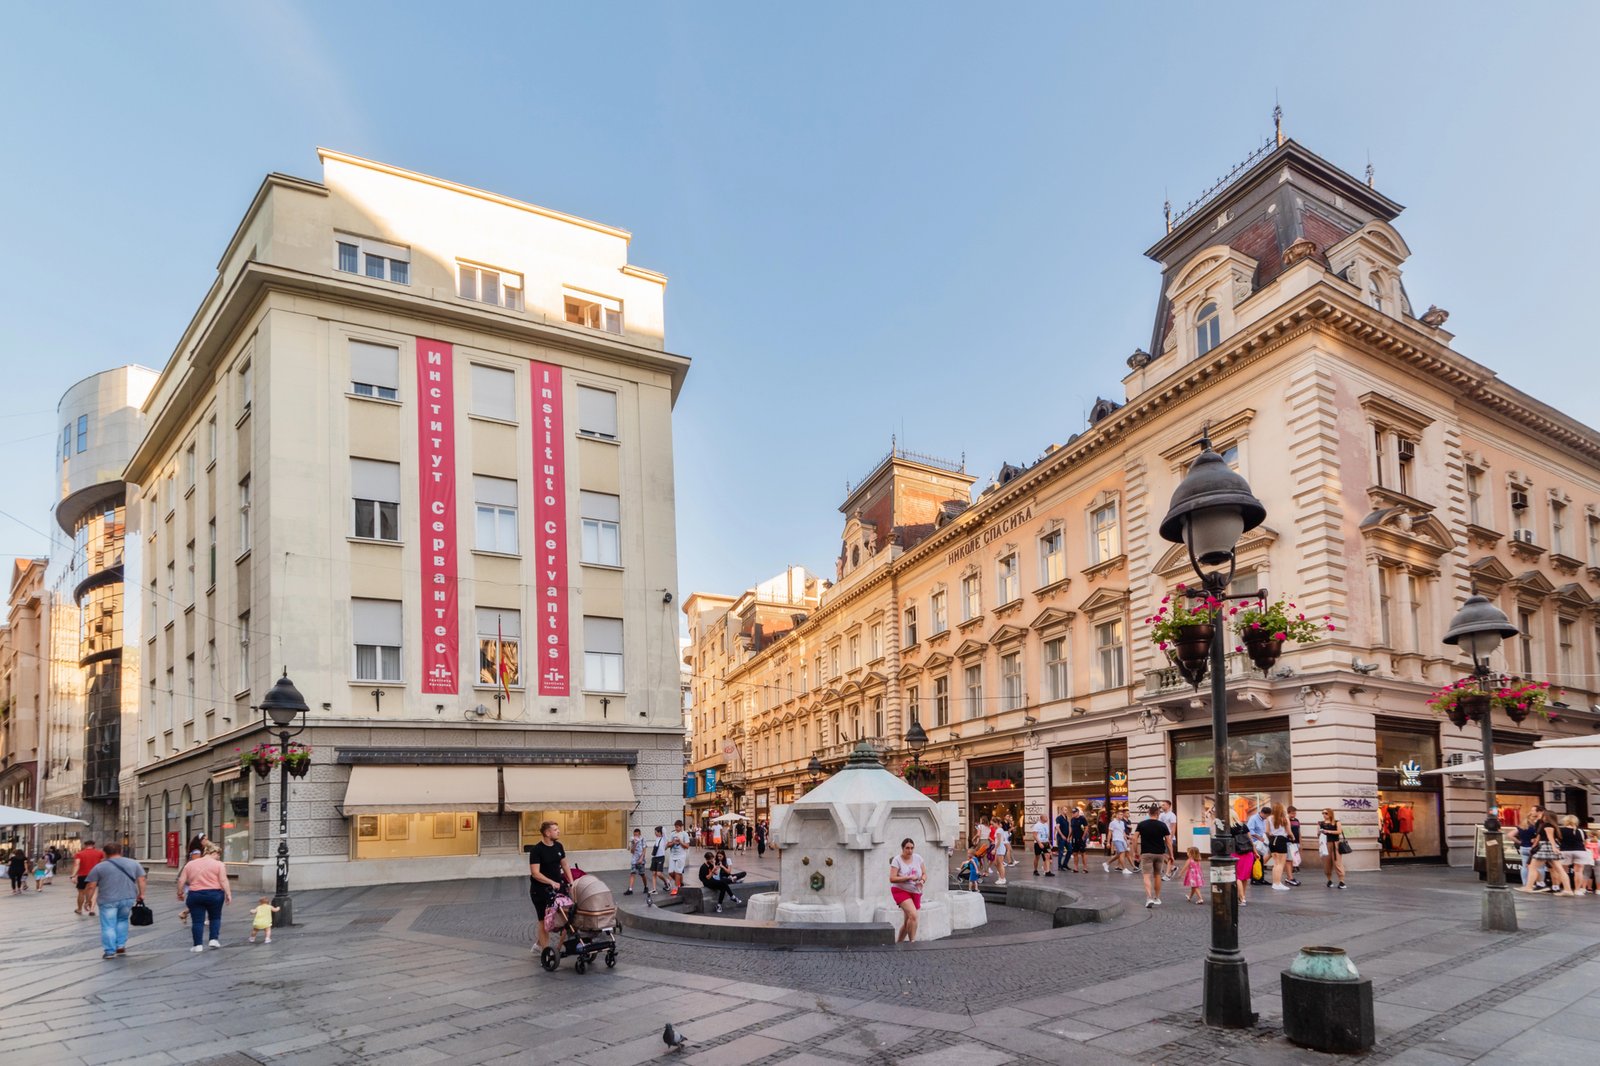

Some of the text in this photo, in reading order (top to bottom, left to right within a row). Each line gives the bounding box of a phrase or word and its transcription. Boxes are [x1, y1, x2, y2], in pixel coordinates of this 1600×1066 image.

[428, 351, 447, 654] Институт Сервантес
[541, 370, 559, 659] Instituto Cervantes
[983, 506, 1032, 545] СПАСИЋА
